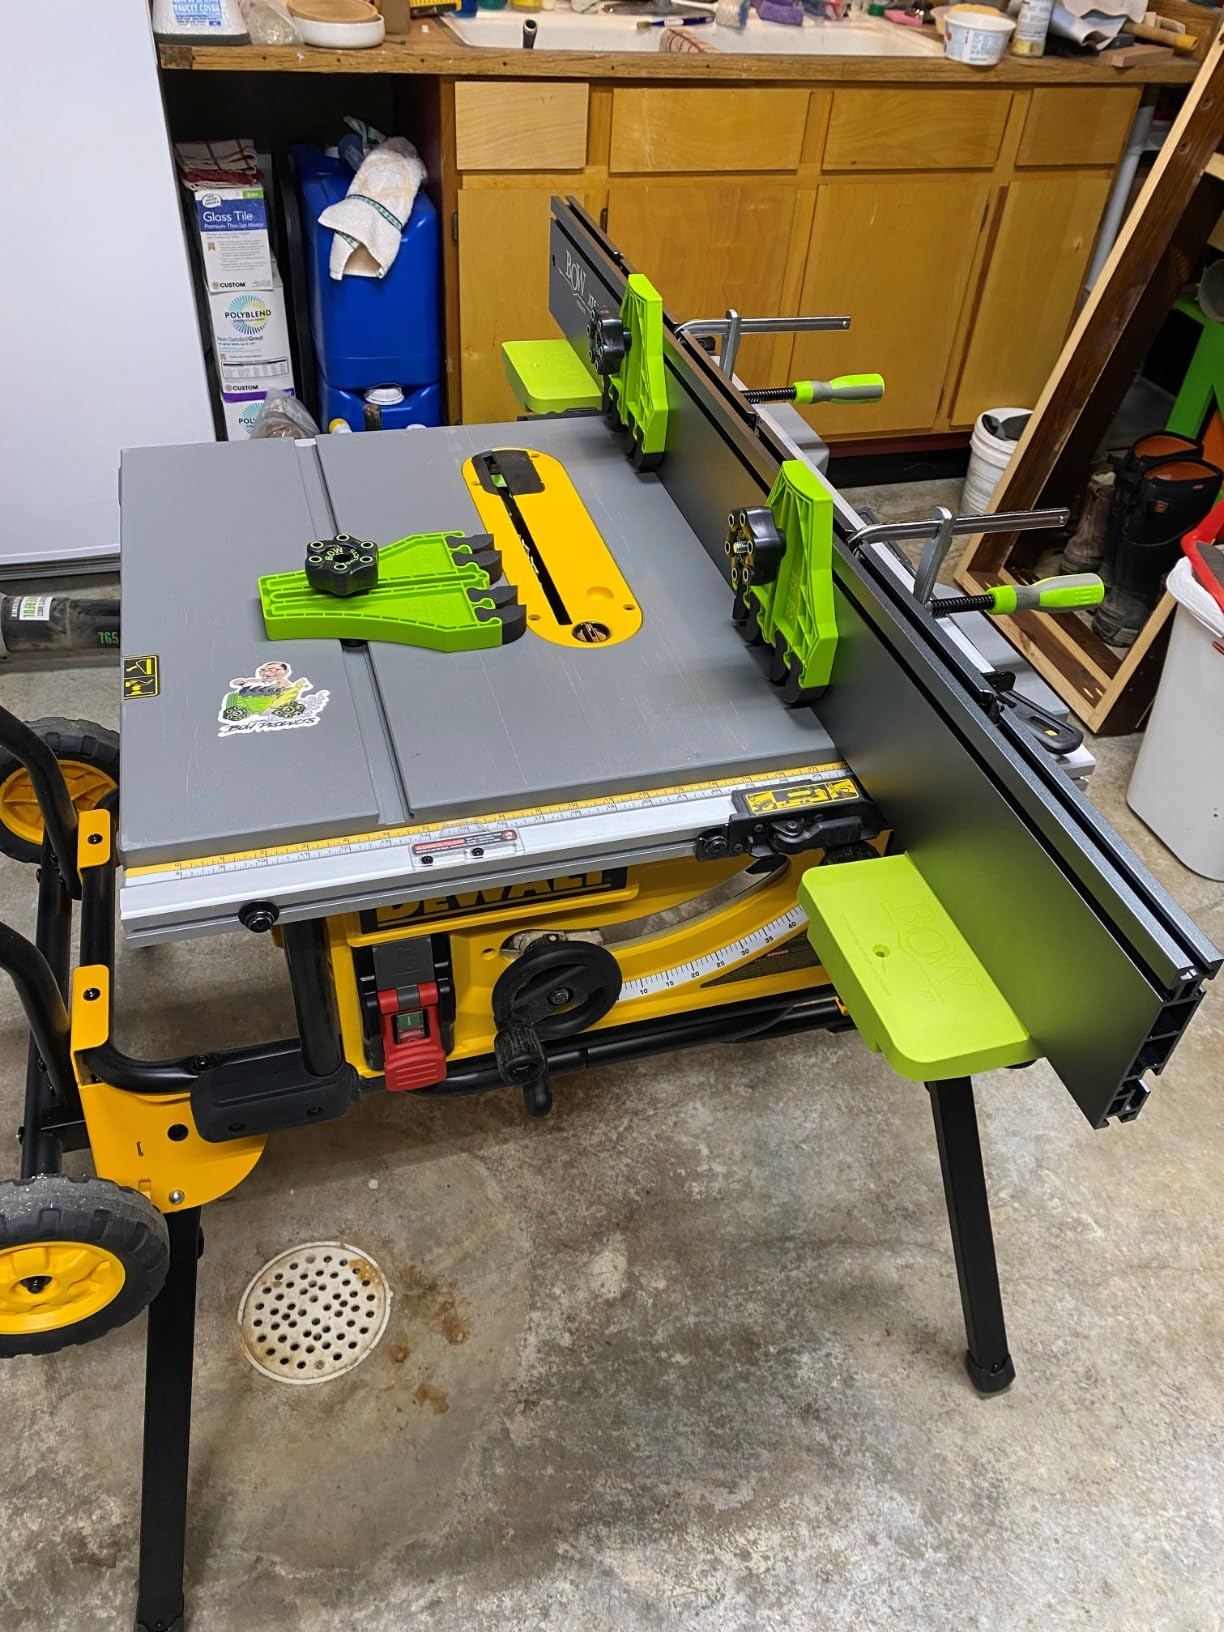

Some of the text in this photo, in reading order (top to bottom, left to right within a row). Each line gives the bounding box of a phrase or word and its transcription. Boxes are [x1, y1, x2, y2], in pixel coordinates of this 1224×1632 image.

[203, 210, 253, 222] Glass Tile
[565, 249, 587, 296] BOW
[225, 310, 271, 318] POLYBLEND
[98, 631, 119, 644] 765
[691, 971, 700, 979] 20
[741, 948, 750, 956] 30
[765, 936, 774, 944] 35
[788, 921, 797, 929] 40
